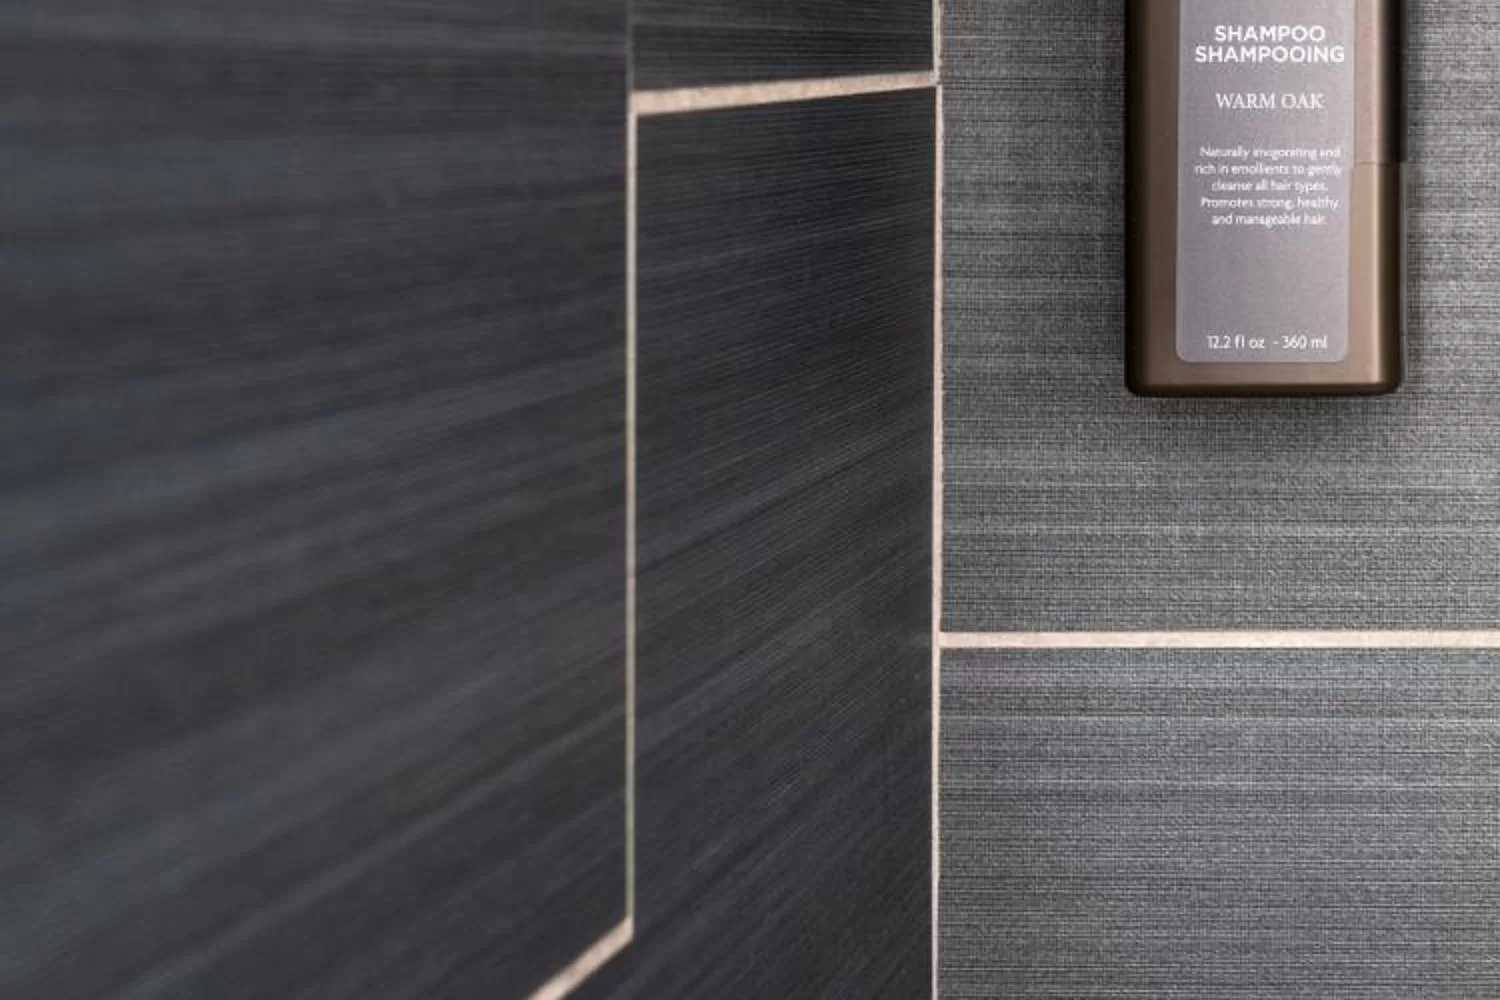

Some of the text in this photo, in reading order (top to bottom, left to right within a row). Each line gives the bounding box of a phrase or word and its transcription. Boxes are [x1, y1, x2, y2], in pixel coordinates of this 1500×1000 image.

[1213, 25, 1326, 42] SHAMPOO
[1194, 45, 1345, 63] SHAMPOOING
[1215, 92, 1325, 109] WARM OAK
[1199, 146, 1249, 160] Naturally
[1211, 213, 1233, 225] and
[1207, 335, 1231, 349] 12.2
[1234, 335, 1245, 349] fl
[1248, 338, 1265, 349] oz
[1282, 335, 1307, 349] 360
[1311, 335, 1328, 349] ml
